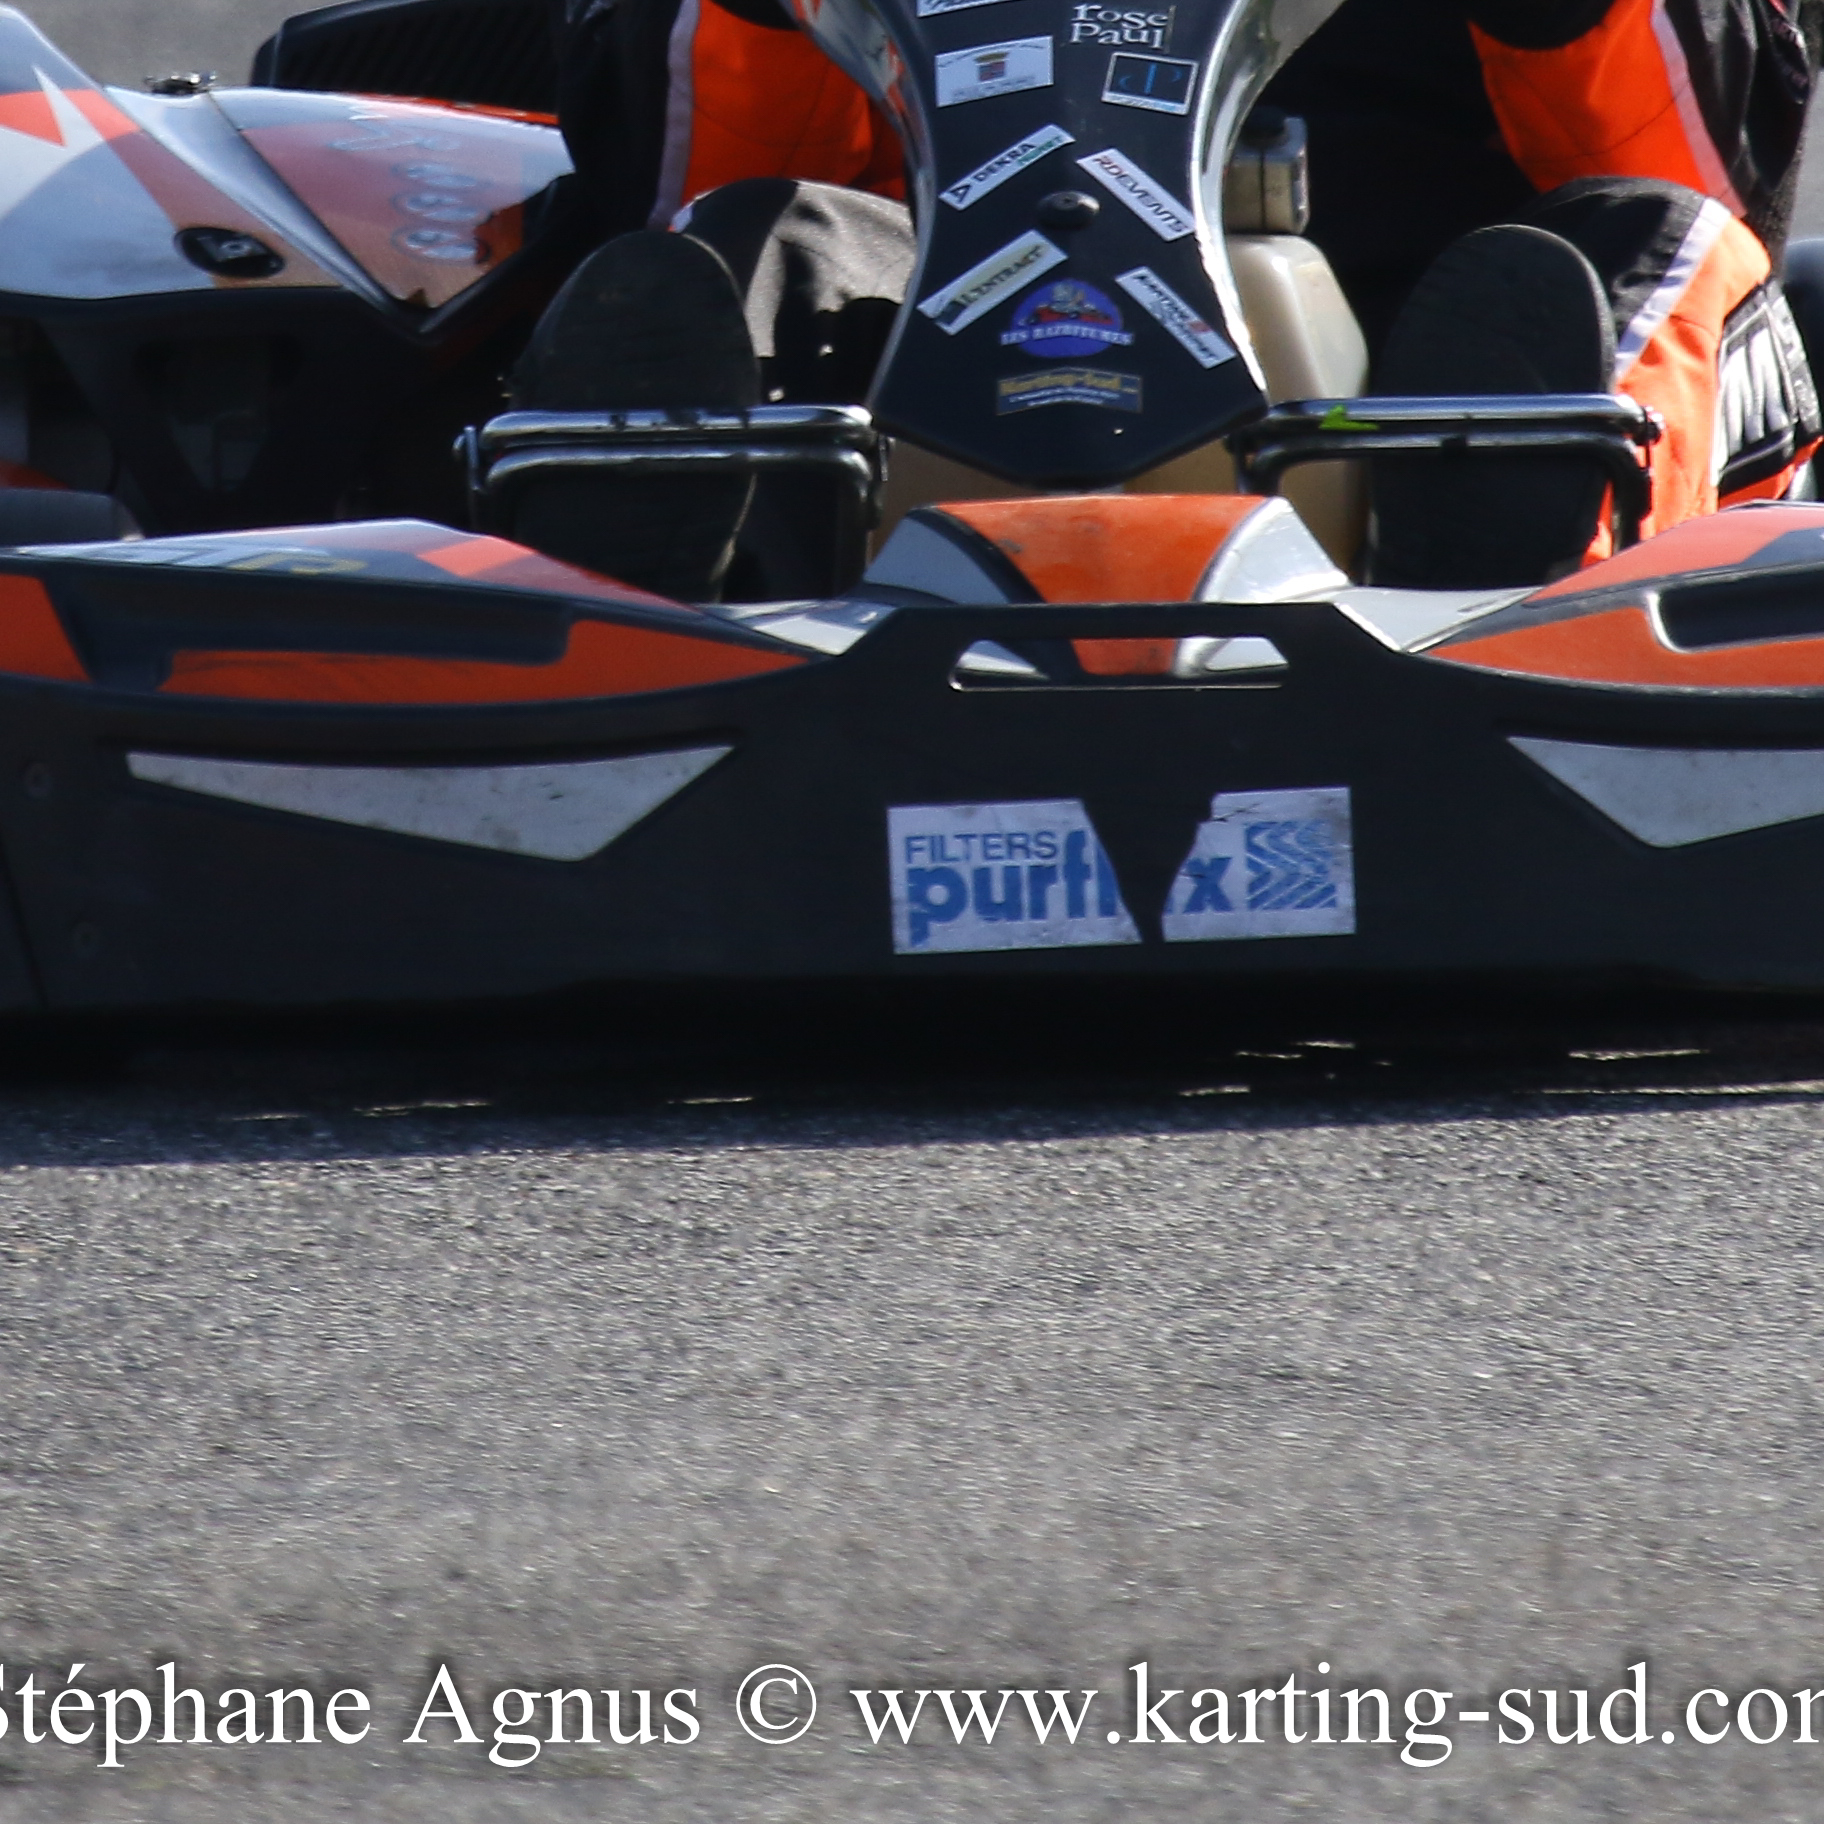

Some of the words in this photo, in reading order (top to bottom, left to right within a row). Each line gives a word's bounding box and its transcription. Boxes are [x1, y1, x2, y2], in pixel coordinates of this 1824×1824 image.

[973, 141, 1036, 183] DEKRA
[905, 830, 1058, 864] FILTERS
[906, 829, 1233, 948] purflx
